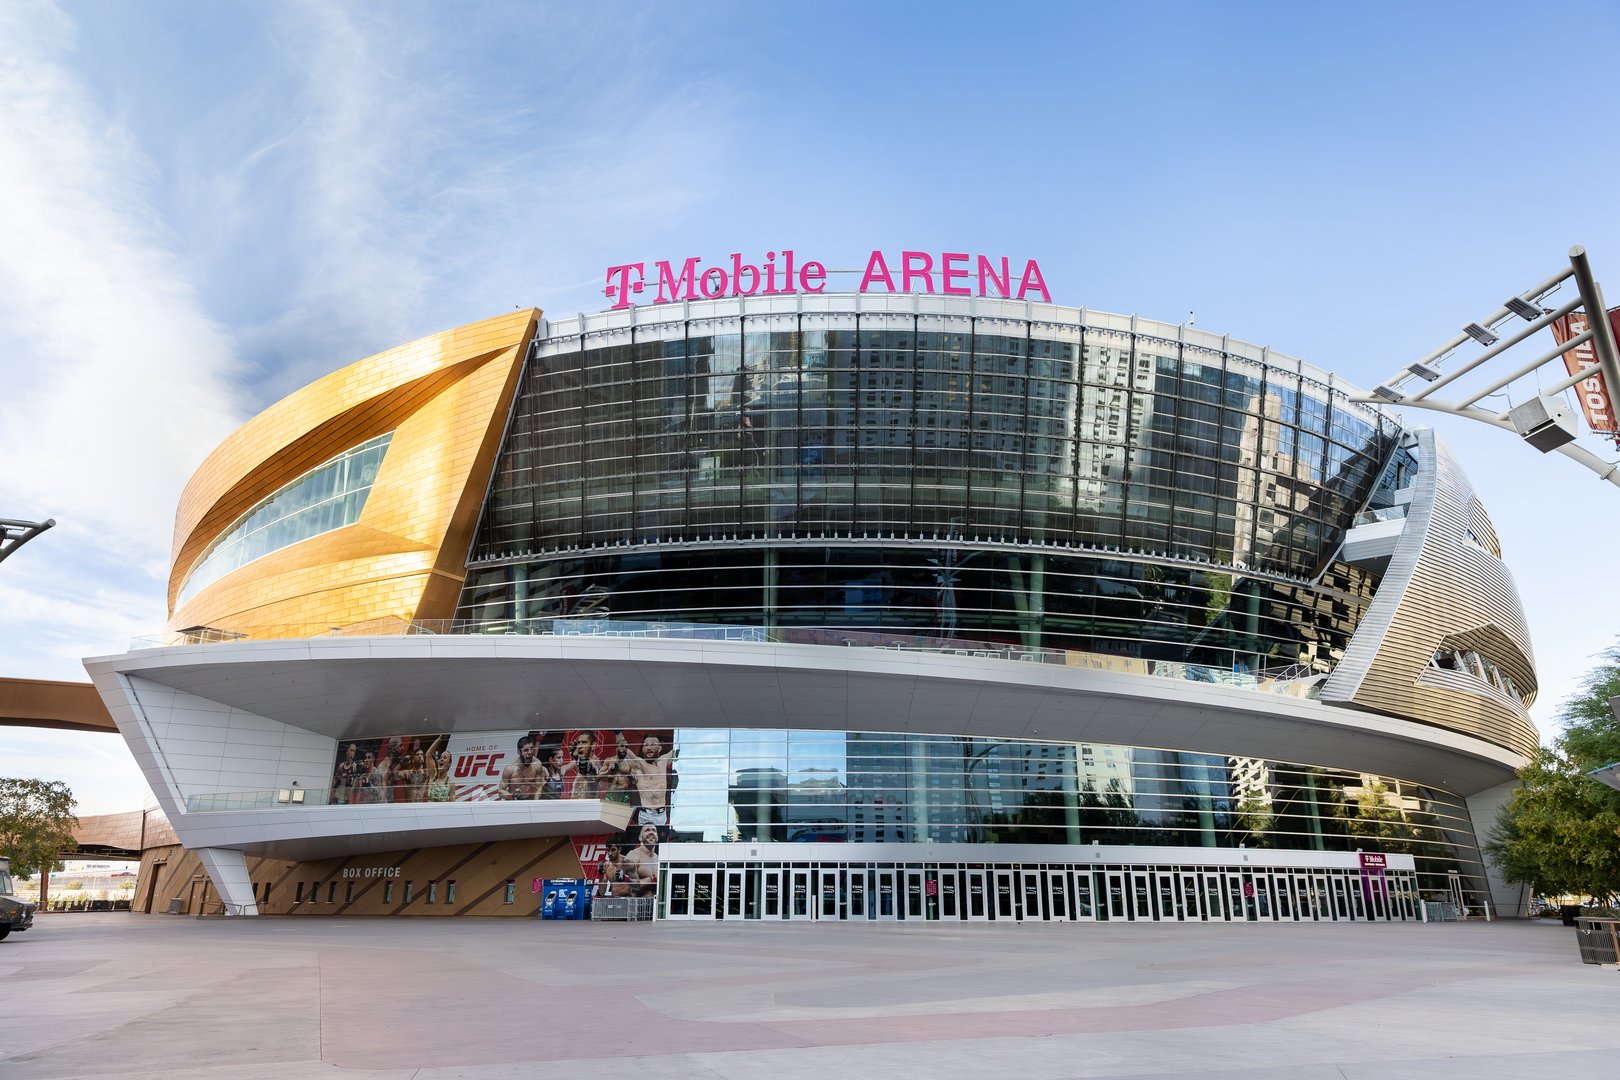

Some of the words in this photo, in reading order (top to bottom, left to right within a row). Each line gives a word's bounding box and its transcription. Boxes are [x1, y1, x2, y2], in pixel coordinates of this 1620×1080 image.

[653, 250, 827, 304] Mobile
[859, 250, 1052, 303] ARENA
[454, 753, 505, 778] UFC
[579, 844, 610, 862] UF
[342, 868, 361, 878] BOX
[364, 867, 401, 877] OFFICE
